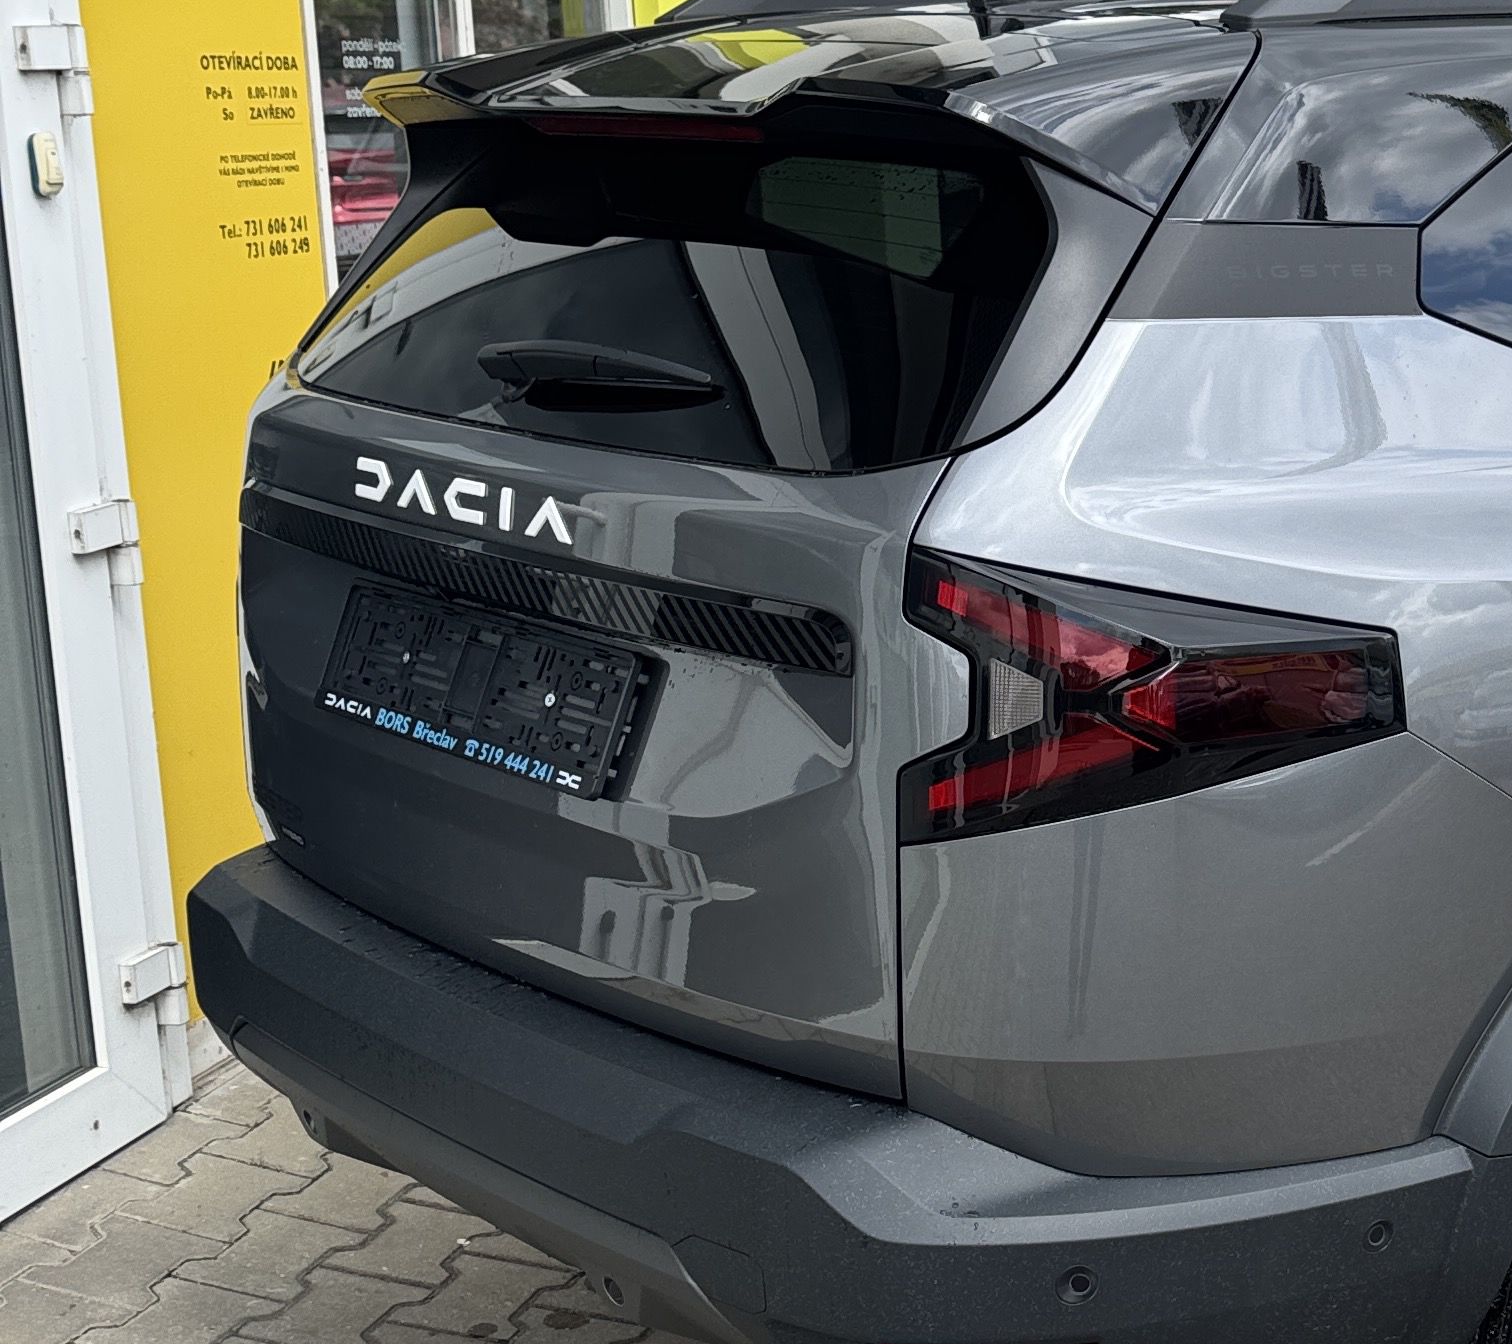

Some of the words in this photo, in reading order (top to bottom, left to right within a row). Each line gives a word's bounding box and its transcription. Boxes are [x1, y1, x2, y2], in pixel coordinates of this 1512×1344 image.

[200, 50, 264, 71] OTEVÍRACÍ
[266, 55, 298, 71] DOBA
[205, 85, 233, 100] Po-Pá
[291, 86, 298, 98] h
[222, 107, 235, 121] So
[249, 103, 295, 120] ZAVŘENO
[244, 218, 264, 236] 731
[268, 217, 287, 235] 606
[290, 215, 308, 233] 241
[246, 240, 265, 258] 731
[269, 239, 288, 256] 606
[291, 237, 310, 254] 249
[1228, 263, 1393, 280] BIGSTER
[354, 456, 574, 545] DACIA
[324, 692, 372, 720] DACIA
[374, 707, 412, 734] BORS
[412, 720, 458, 751] Břeclav
[478, 743, 504, 766] 519
[504, 751, 530, 775] 444
[529, 759, 555, 784] 241
